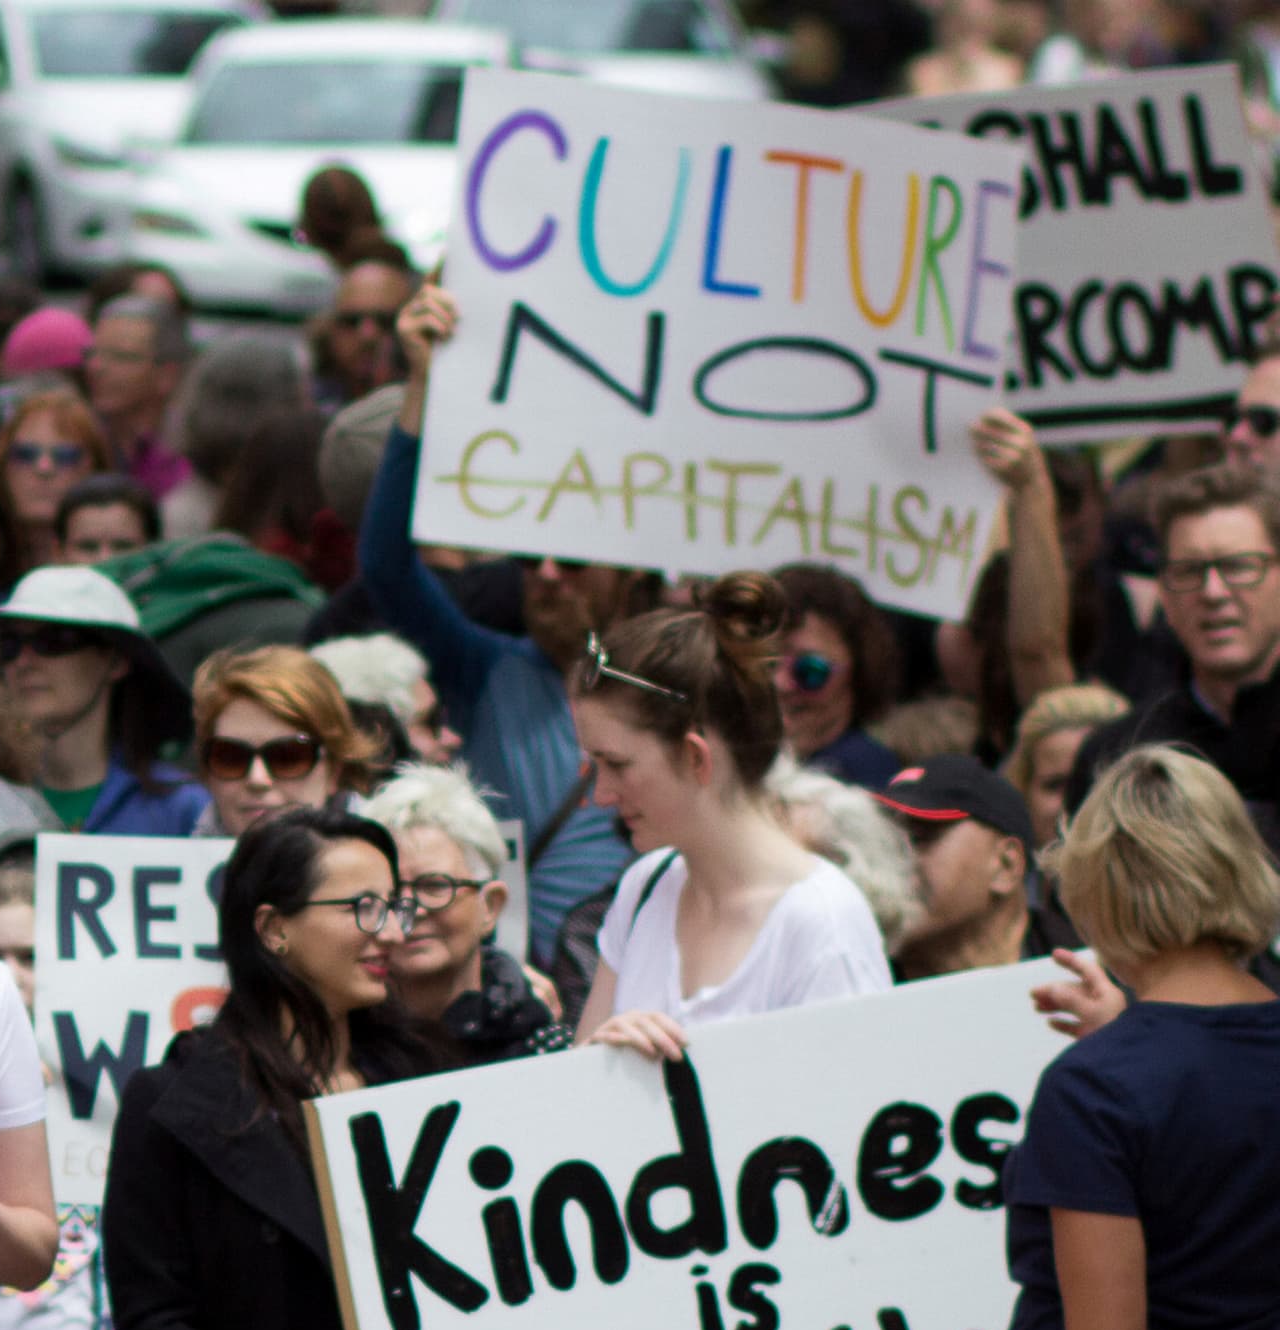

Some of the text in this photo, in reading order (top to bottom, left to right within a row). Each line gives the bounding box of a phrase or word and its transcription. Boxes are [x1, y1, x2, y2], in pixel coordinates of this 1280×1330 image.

[466, 108, 1014, 361] CULTURE
[490, 299, 997, 455] NOT
[459, 428, 977, 592] CAPITALISM
